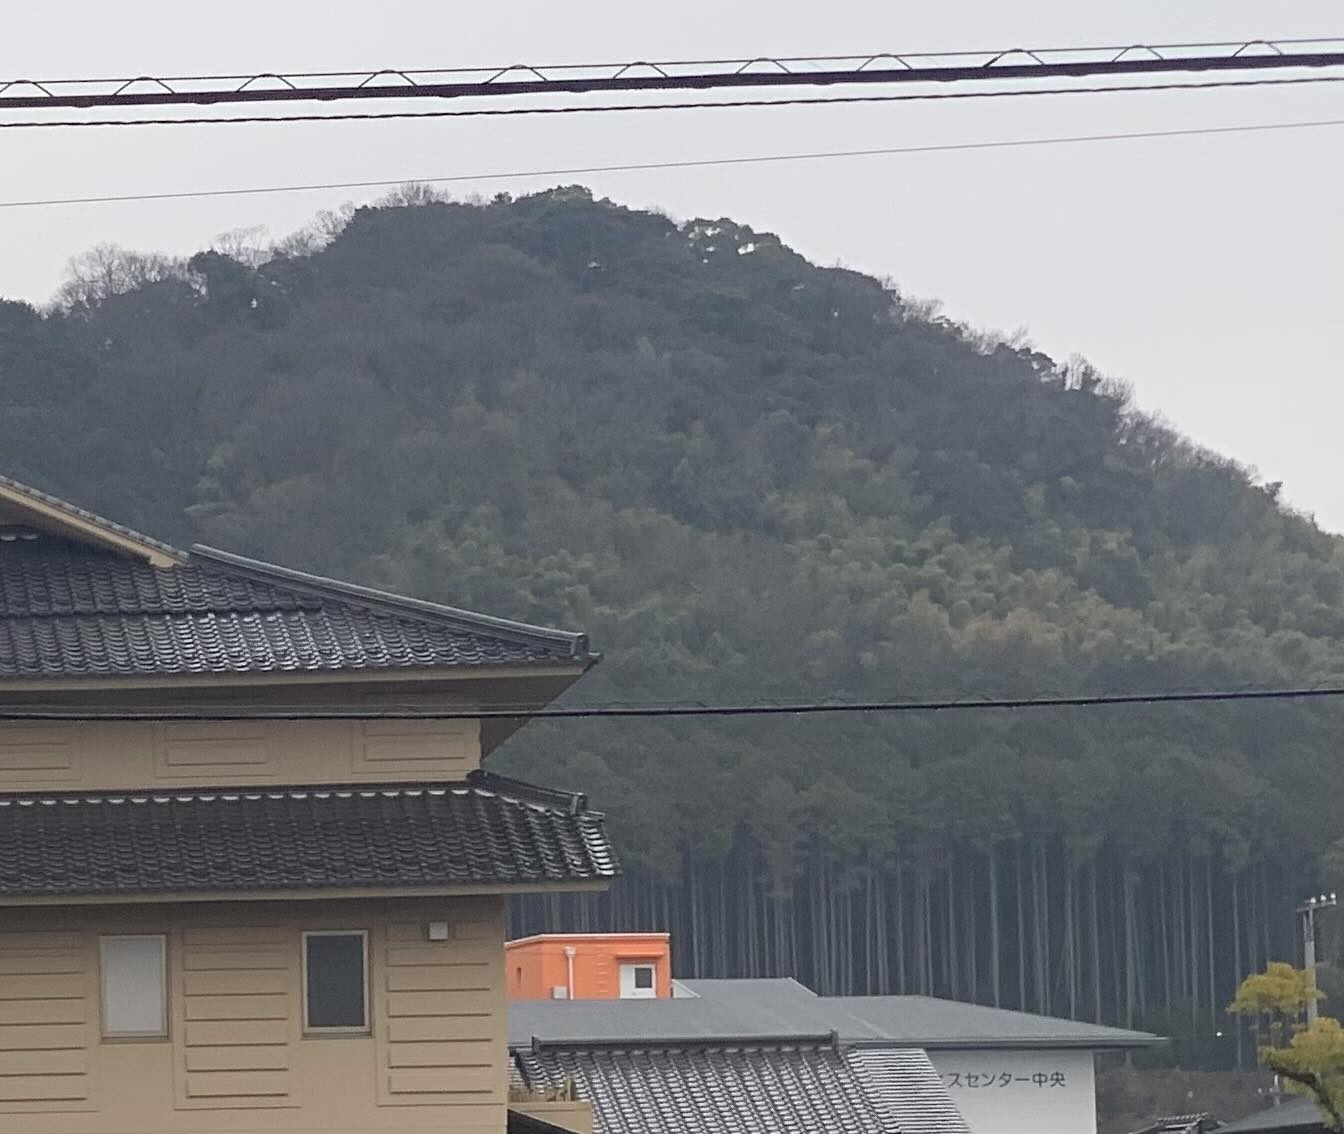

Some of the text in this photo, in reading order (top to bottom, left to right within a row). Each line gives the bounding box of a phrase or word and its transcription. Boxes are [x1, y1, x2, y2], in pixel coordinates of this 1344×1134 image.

[938, 1071, 1066, 1088] スセンター中央
